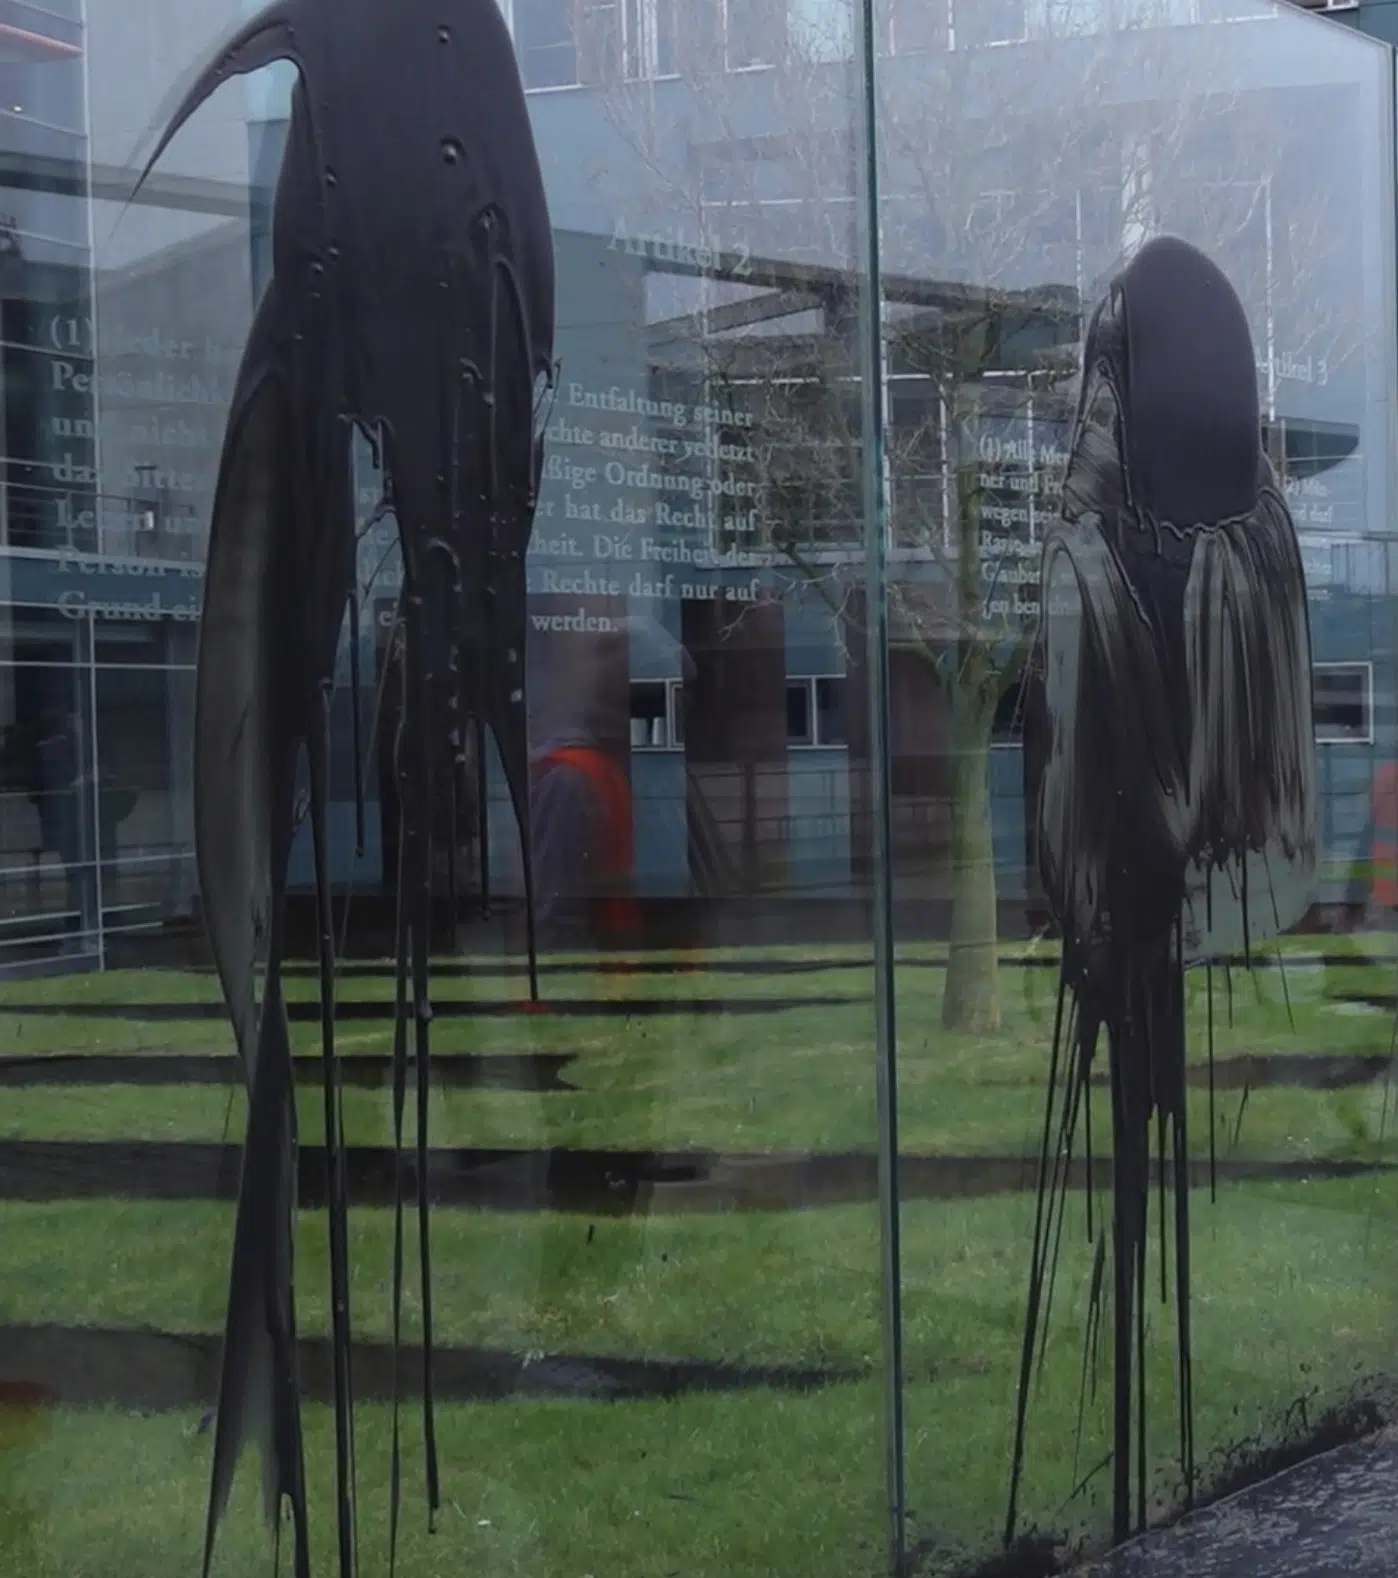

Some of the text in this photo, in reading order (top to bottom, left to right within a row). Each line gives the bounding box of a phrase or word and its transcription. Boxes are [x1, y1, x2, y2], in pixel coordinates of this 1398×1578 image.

[606, 215, 752, 276] Artikel 2
[569, 382, 753, 427] Entfaltung seiner
[600, 425, 677, 455] anderer
[604, 460, 705, 499] Ordnung
[711, 473, 757, 496] oder
[1010, 472, 1039, 493] und
[564, 494, 605, 521] hat
[610, 498, 646, 524] das
[655, 502, 717, 529] Recht
[724, 509, 758, 531] auf
[981, 506, 1028, 527] wegen
[593, 535, 632, 560] Die
[640, 537, 718, 565] Freiheit
[543, 569, 760, 601] Rechte darf nur auf
[57, 590, 162, 620] Grund
[530, 607, 619, 633] werden.
